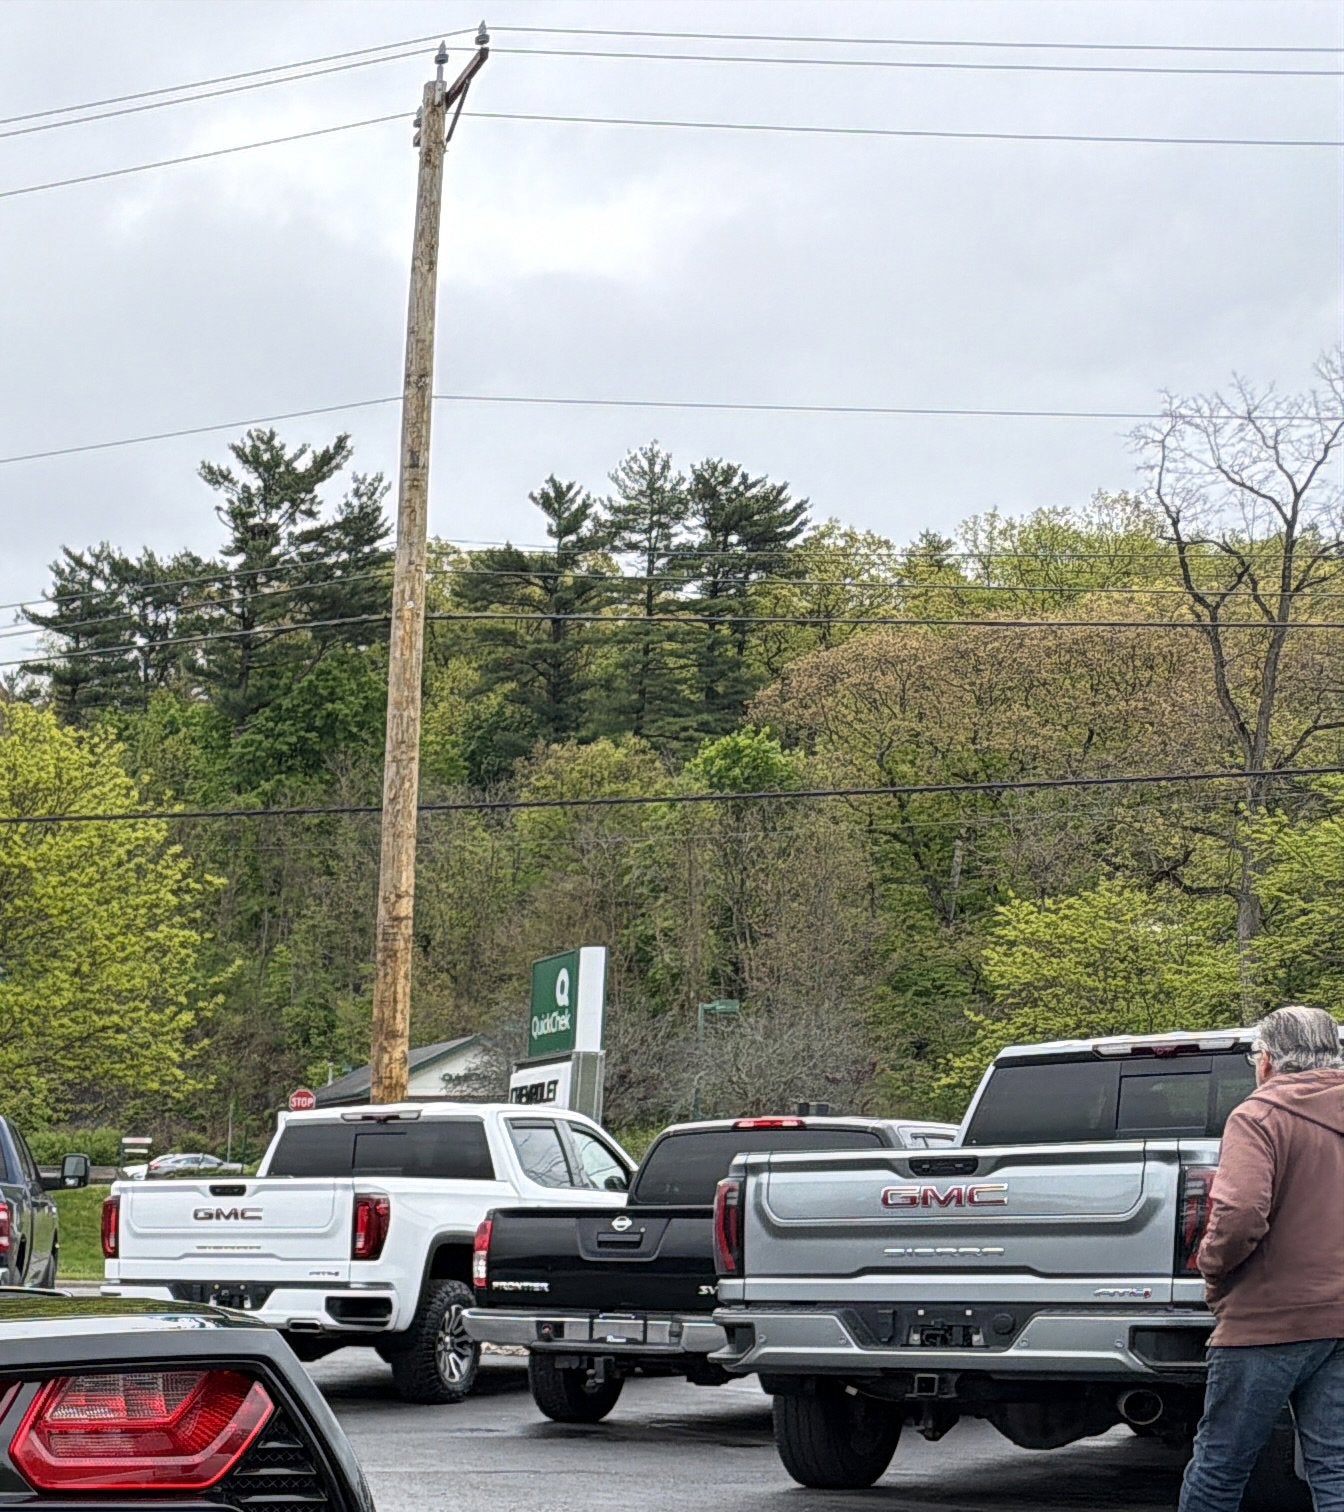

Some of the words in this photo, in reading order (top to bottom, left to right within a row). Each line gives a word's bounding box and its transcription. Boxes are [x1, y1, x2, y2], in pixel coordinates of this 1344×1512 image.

[531, 1008, 570, 1040] QuickChek
[291, 1096, 313, 1108] STOP
[881, 1183, 1009, 1208] GMC
[193, 1207, 263, 1221] GMC
[492, 1281, 550, 1292] FRONTIER
